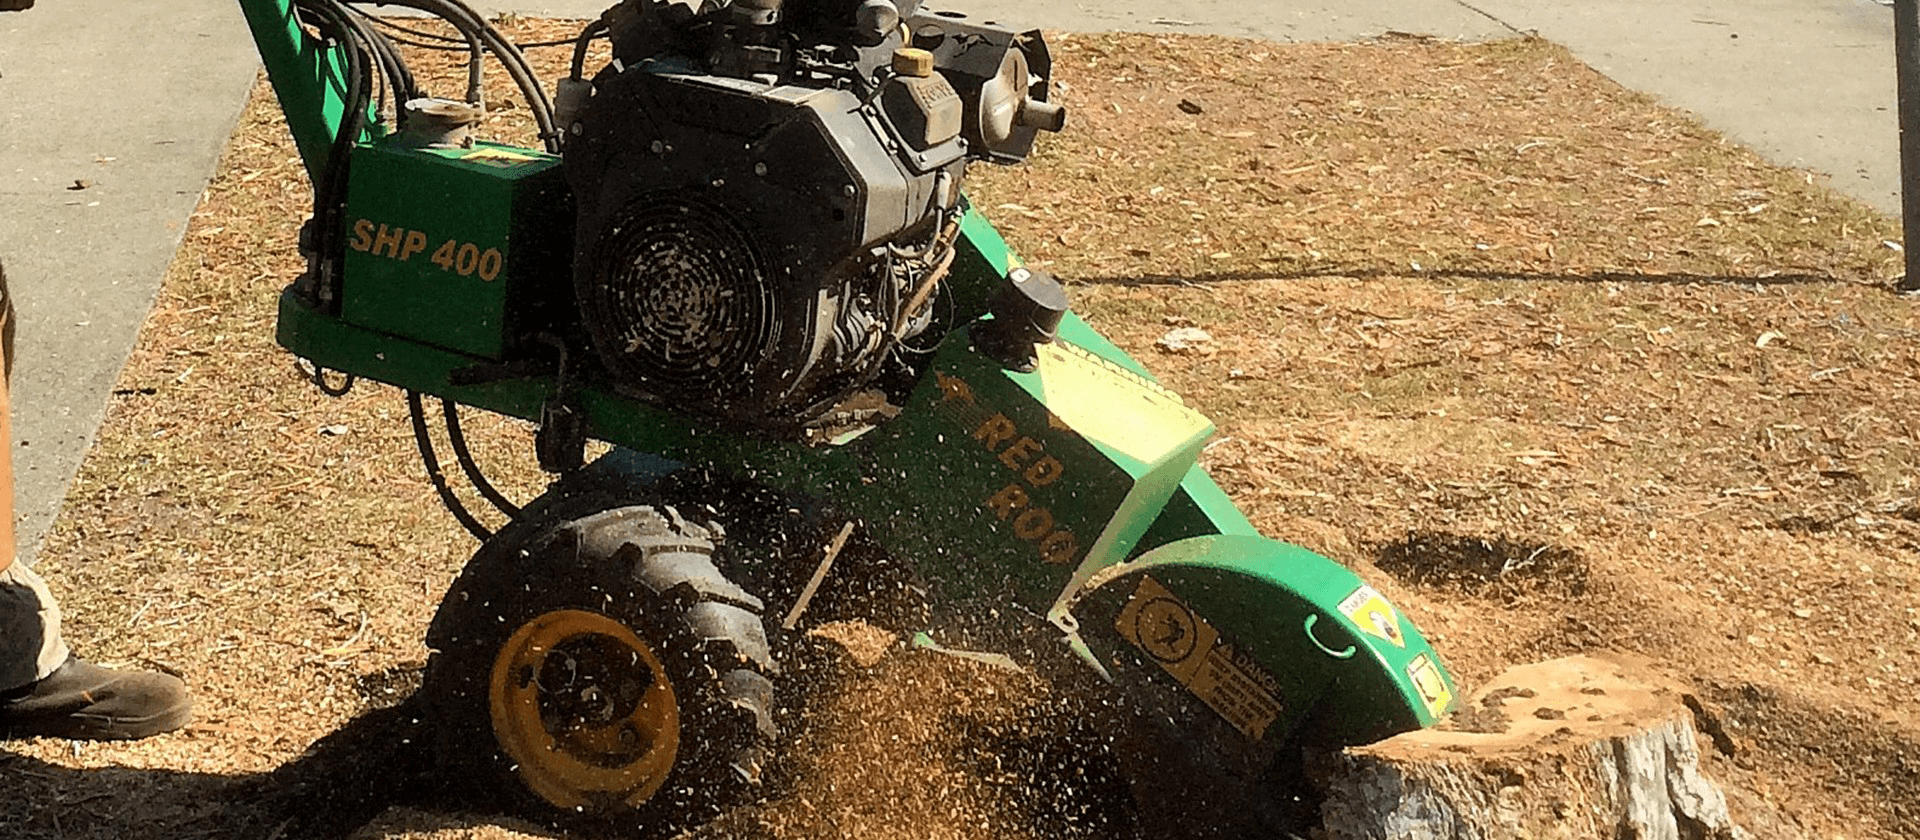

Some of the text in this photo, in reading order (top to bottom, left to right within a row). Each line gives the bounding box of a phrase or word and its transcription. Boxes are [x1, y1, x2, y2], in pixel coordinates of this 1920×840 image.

[350, 218, 502, 282] SHP 400
[973, 411, 1064, 488] RED
[987, 484, 1078, 565] ROO
